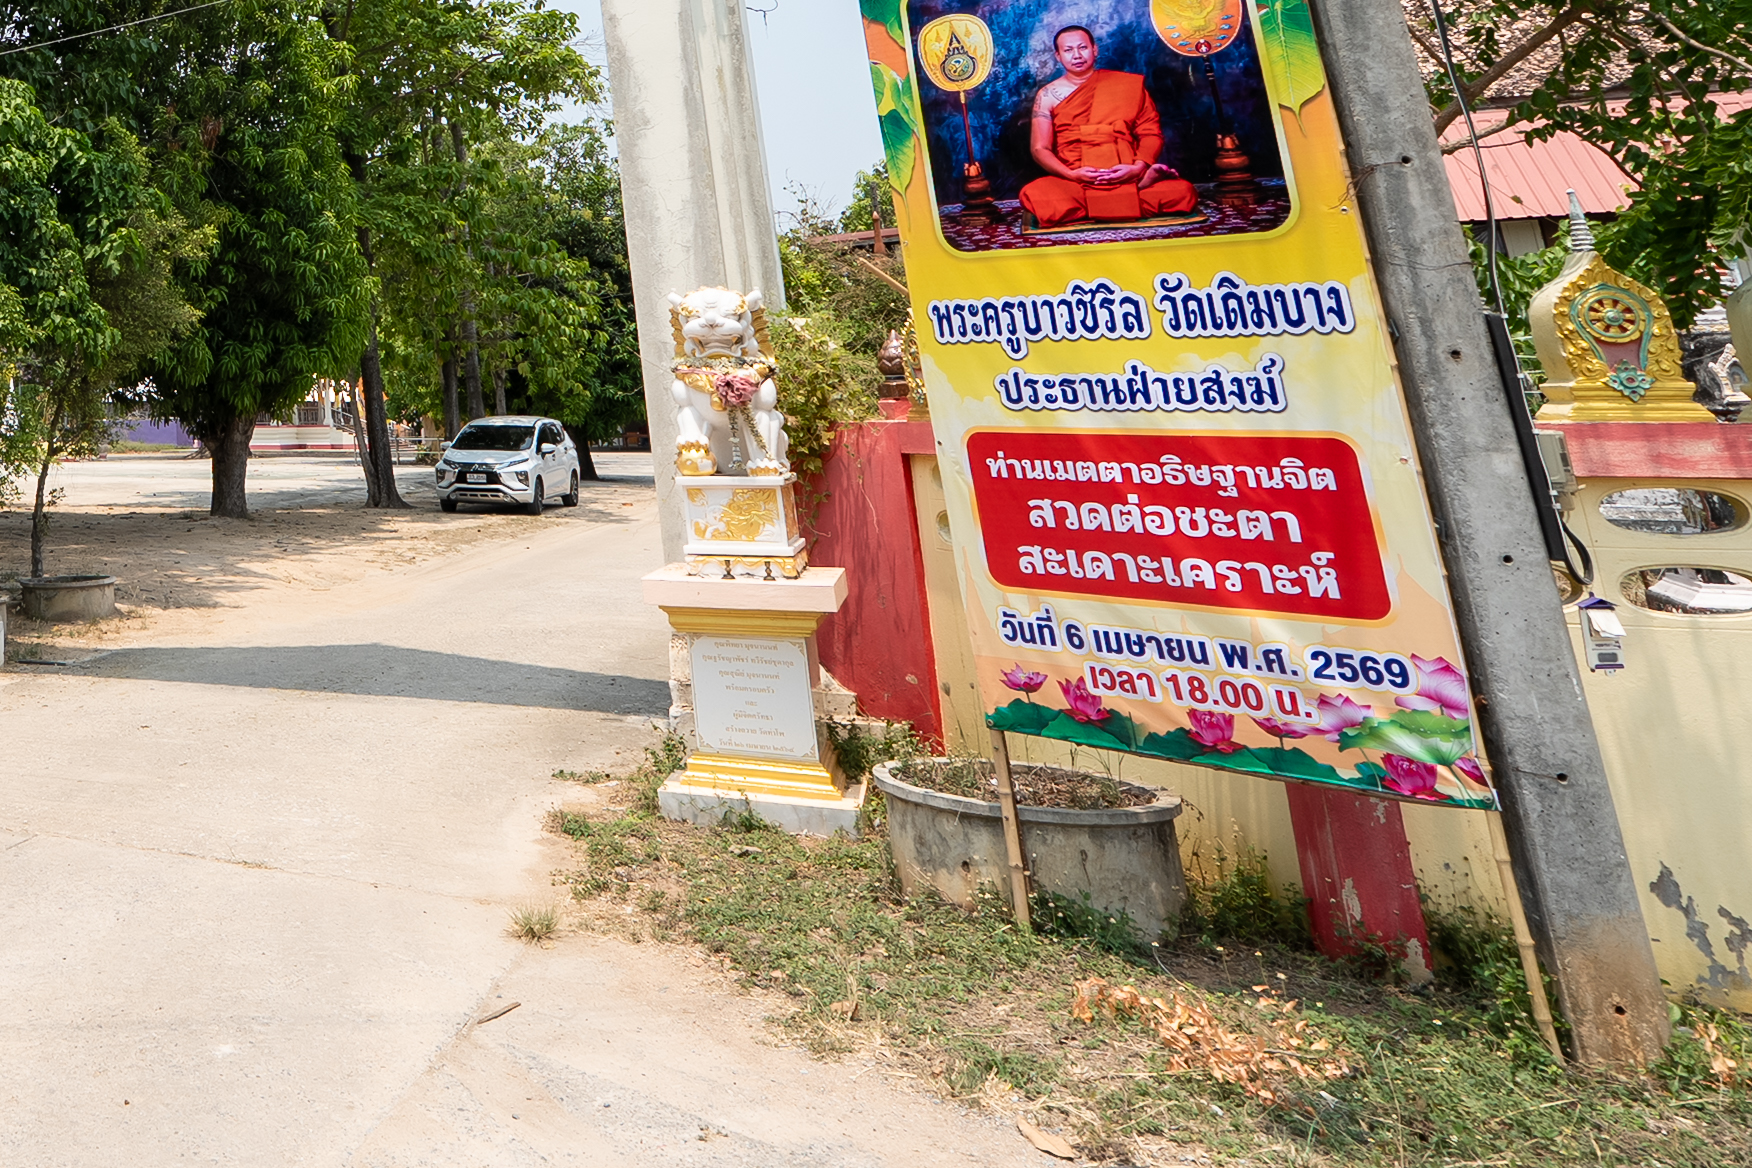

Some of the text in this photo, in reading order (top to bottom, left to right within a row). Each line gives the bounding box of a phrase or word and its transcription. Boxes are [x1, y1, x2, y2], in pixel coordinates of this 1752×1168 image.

[1159, 276, 1347, 332] วัดเดิมบาง
[1001, 358, 1280, 409] ประธานฝ่ายสงฆ์
[986, 451, 1337, 497] ท่านเมตตาอธิษฐานจิต
[1027, 494, 1303, 543] สวดต่อชะตา
[1017, 544, 1342, 601] สะเดาะเคราะห์
[1001, 608, 1411, 689] วันที่ 6 เมษายน พ.ศ. 2569
[1088, 664, 1313, 719] เวลา 18.00 น.
